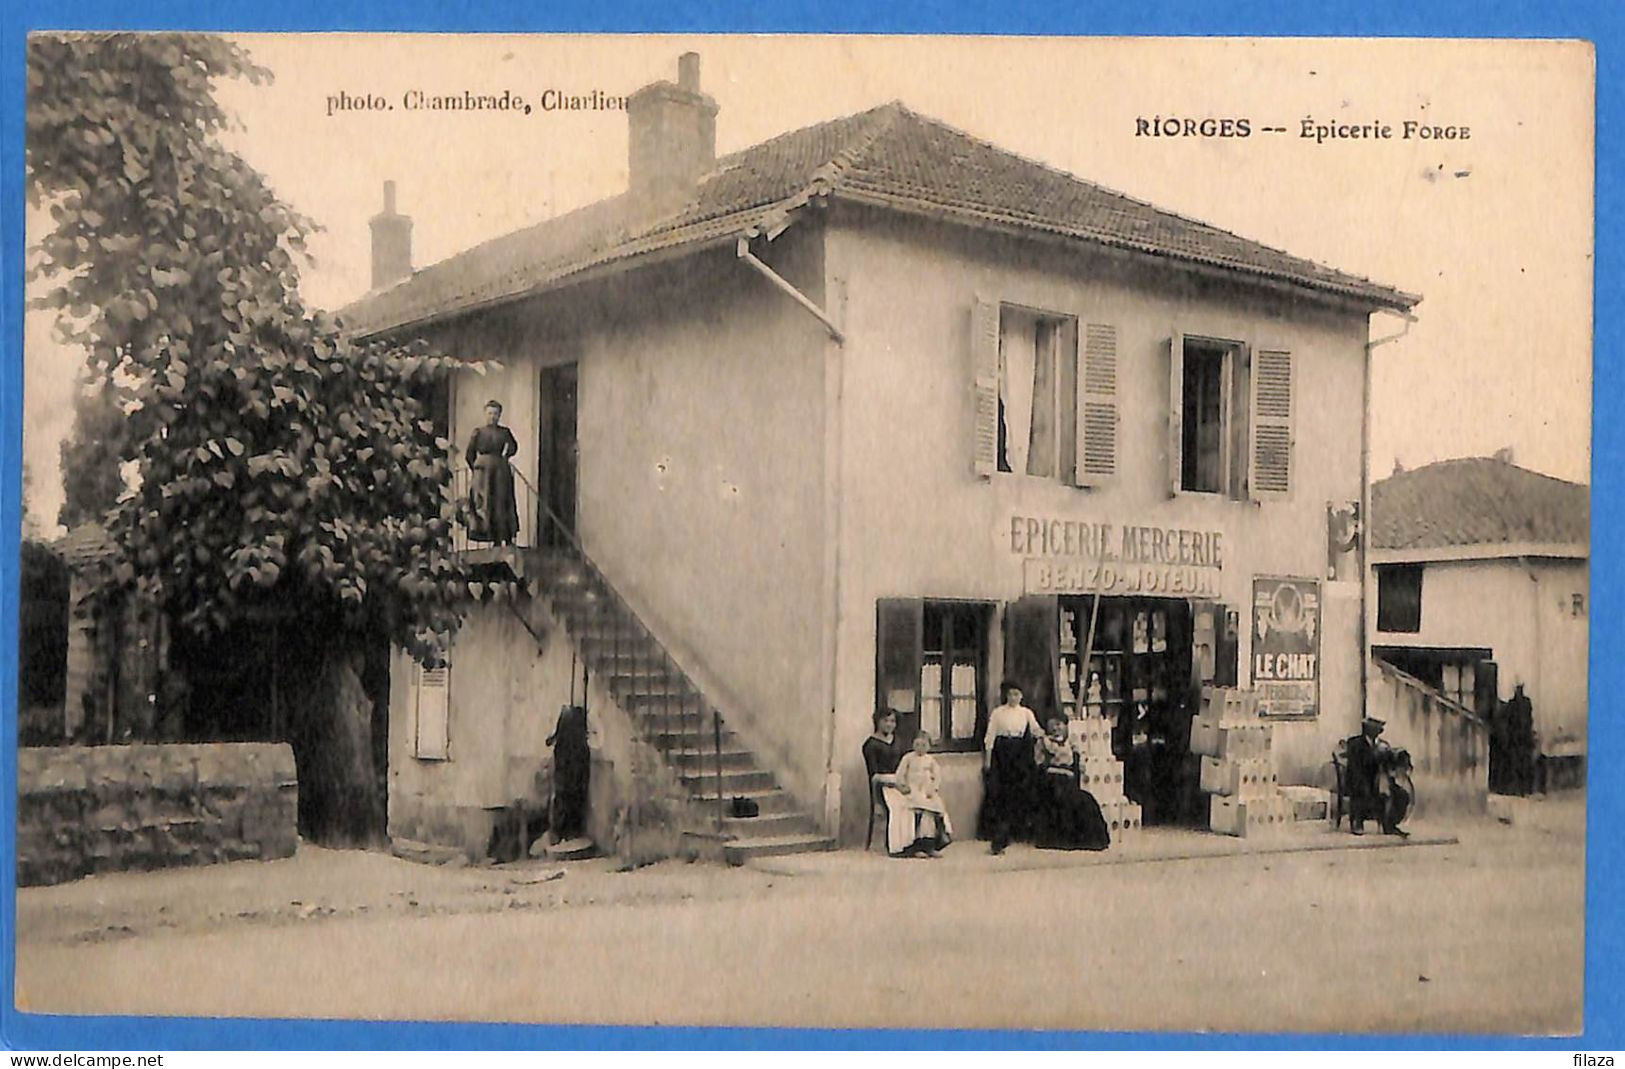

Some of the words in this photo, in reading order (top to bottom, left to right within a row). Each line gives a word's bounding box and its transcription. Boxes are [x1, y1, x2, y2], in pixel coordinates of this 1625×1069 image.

[1122, 524, 1223, 567] MERCERIE
[1255, 653, 1274, 679] LE
[1275, 653, 1316, 680] CHAT
